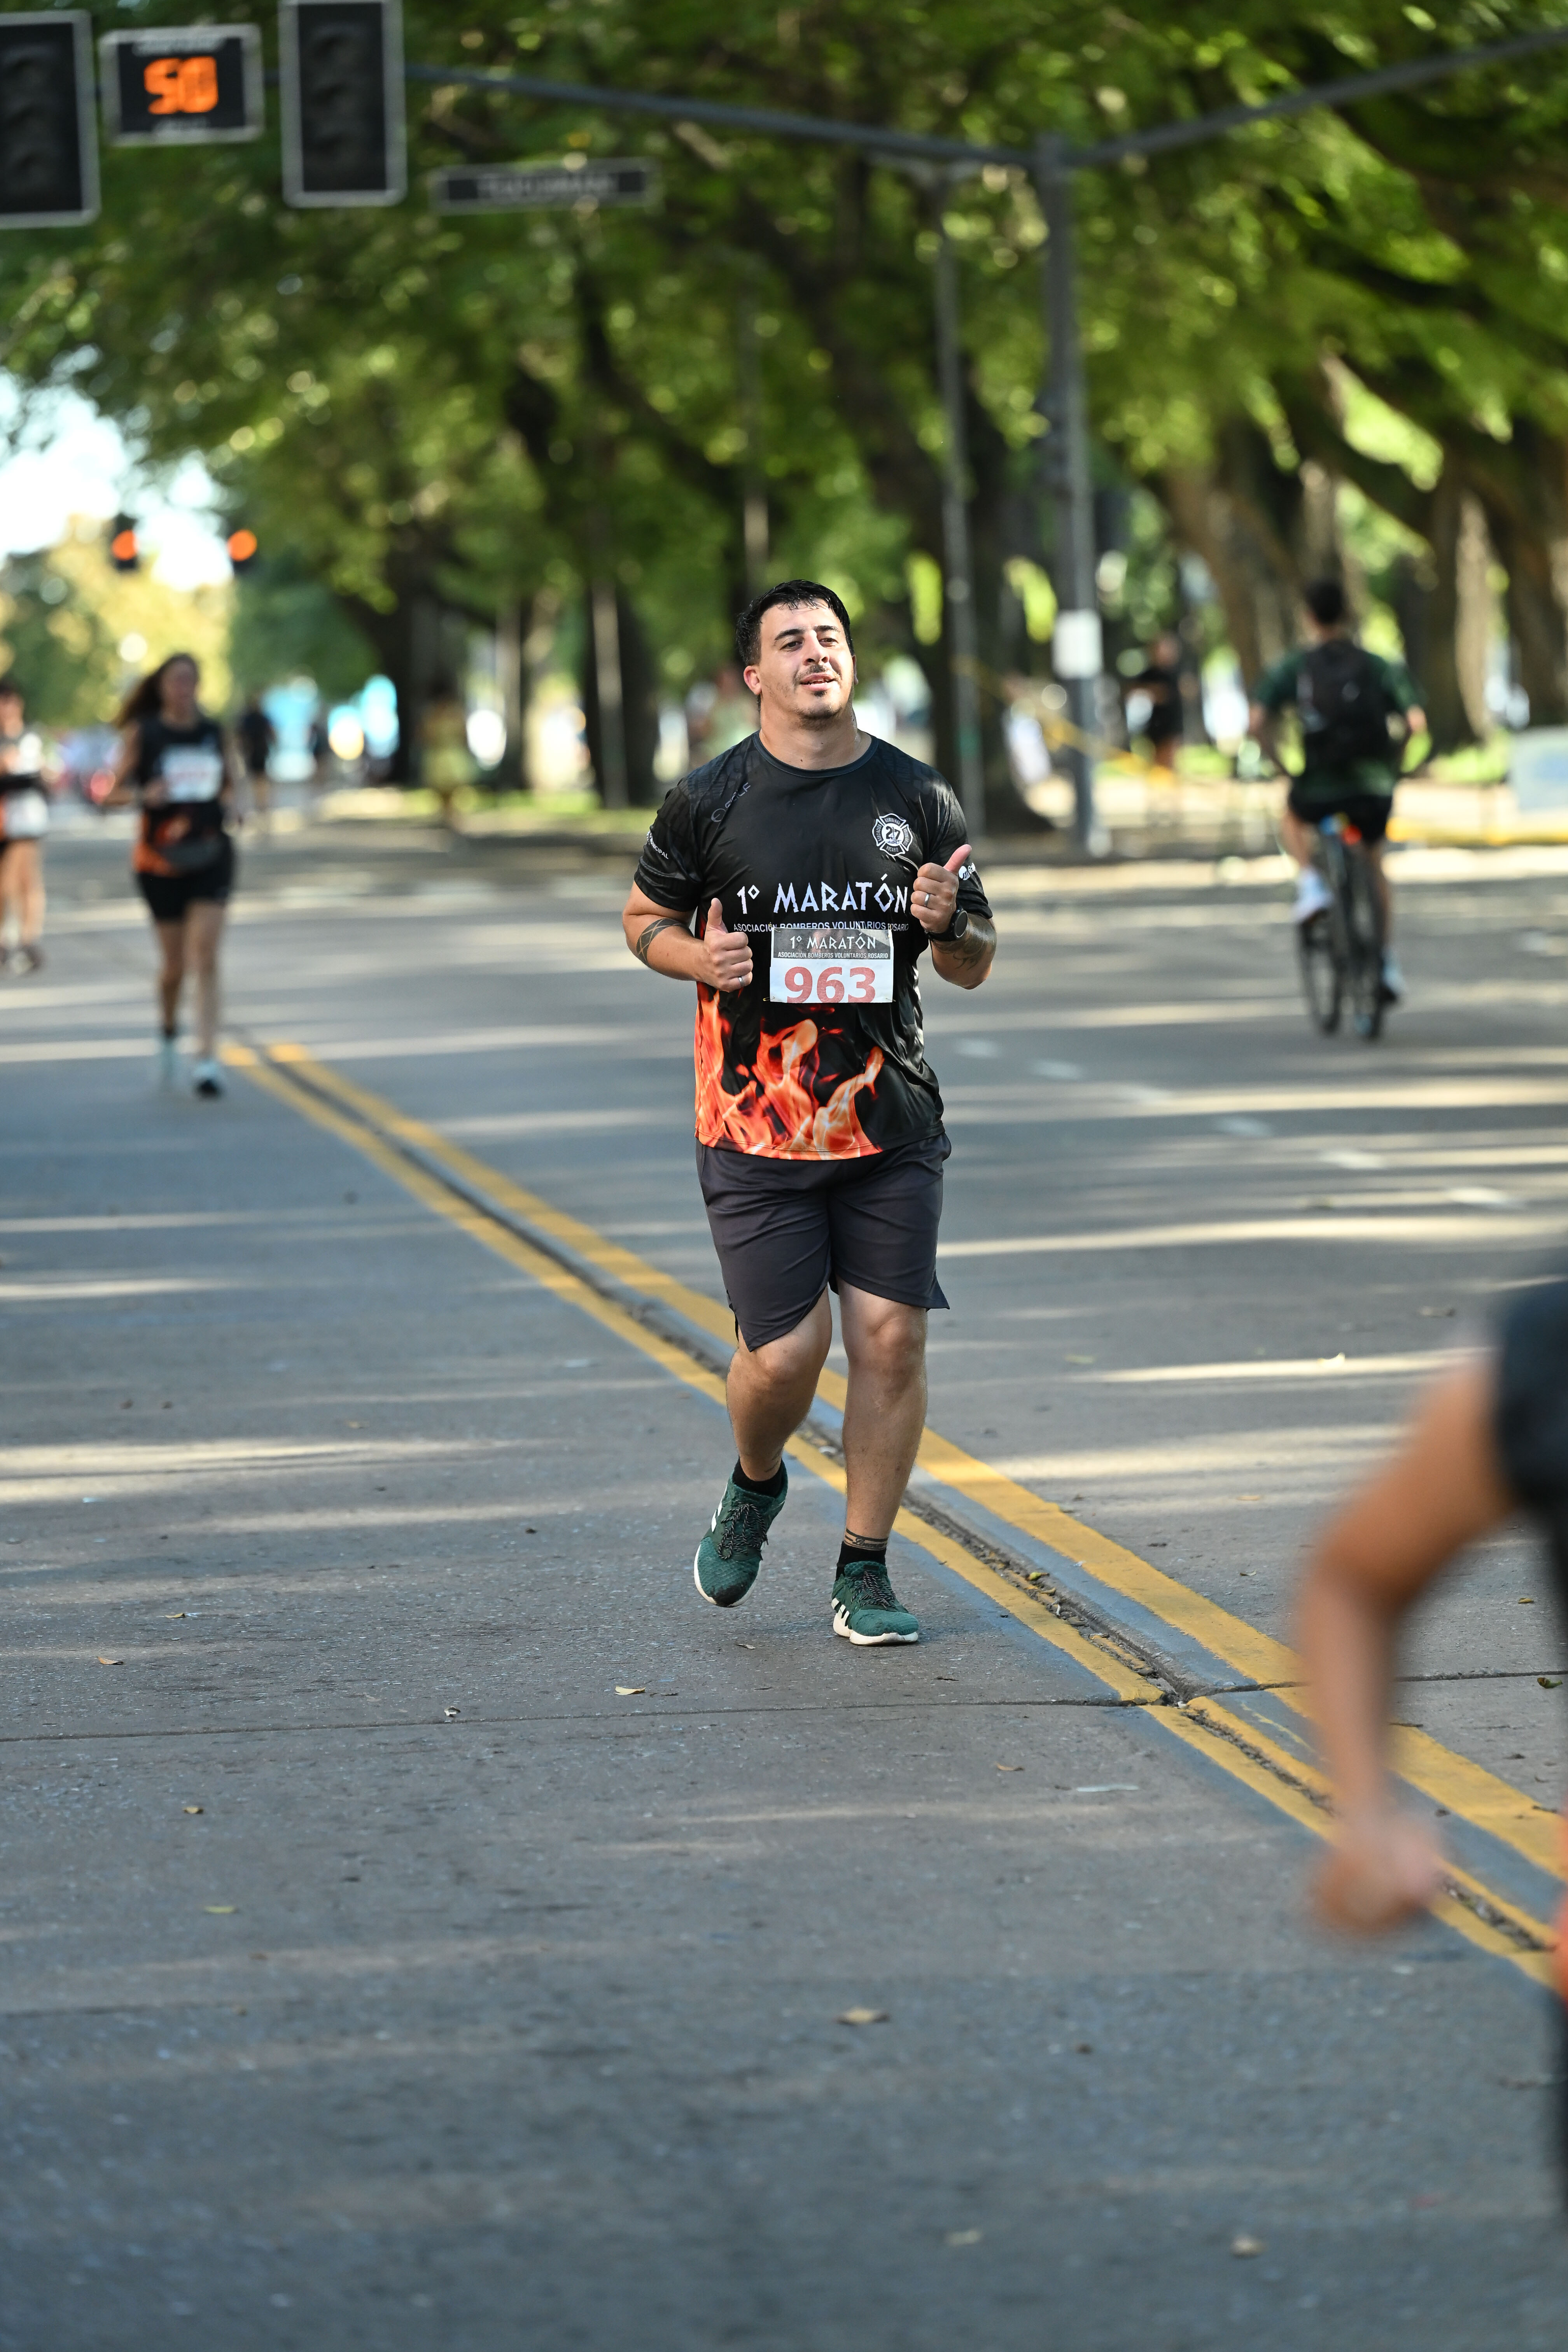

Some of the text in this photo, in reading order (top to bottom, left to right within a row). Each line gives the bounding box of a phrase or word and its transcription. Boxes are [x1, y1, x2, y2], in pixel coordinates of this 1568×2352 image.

[886, 826, 901, 840] 27
[774, 873, 908, 914] MARATÓN
[807, 932, 875, 950] MARATÓN
[785, 966, 875, 1003] 963
